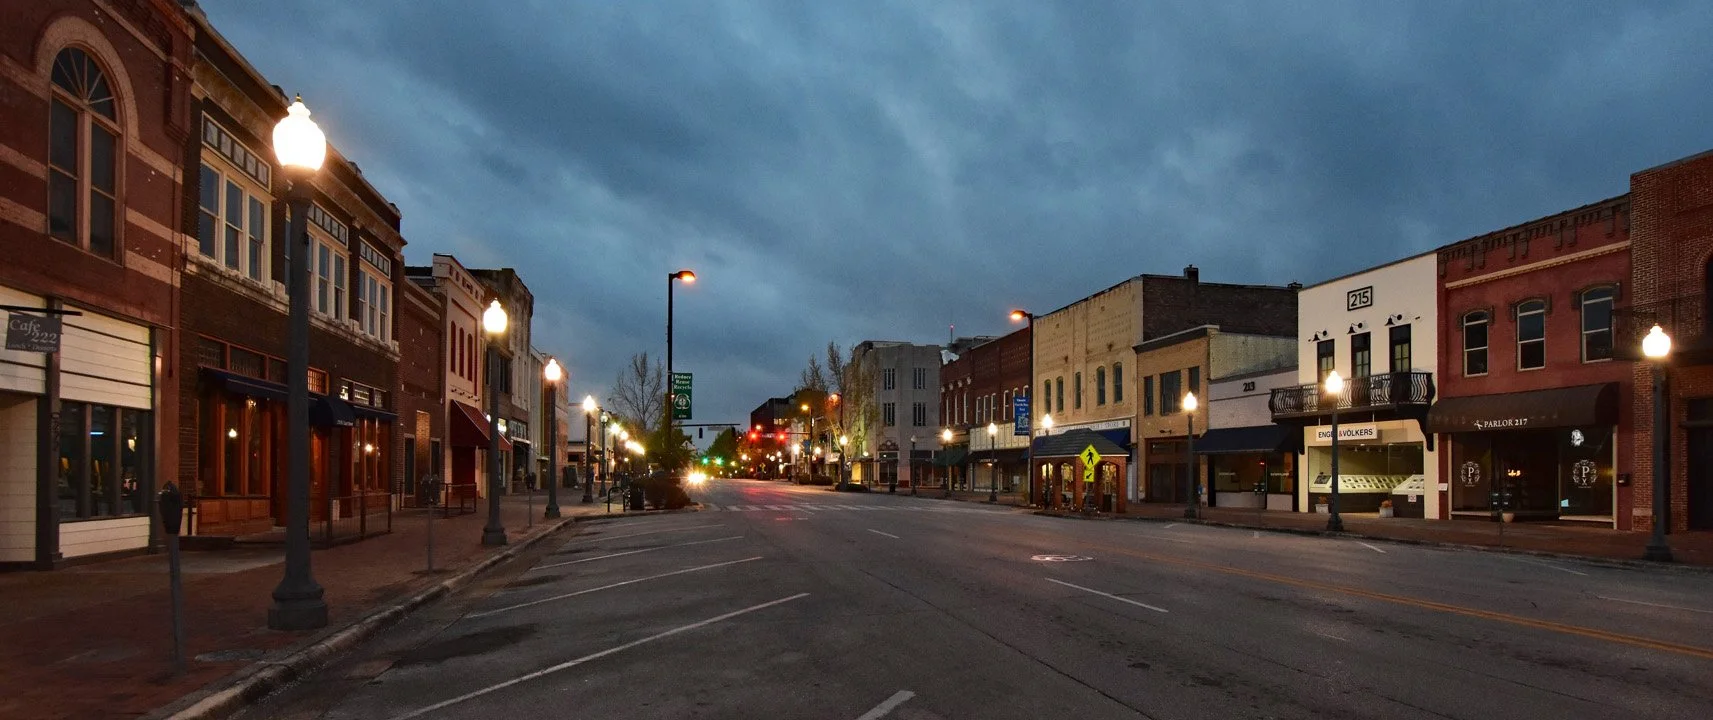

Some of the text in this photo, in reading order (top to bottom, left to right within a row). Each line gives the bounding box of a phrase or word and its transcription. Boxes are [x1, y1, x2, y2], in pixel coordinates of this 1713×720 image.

[1350, 290, 1370, 307] 215
[31, 331, 58, 344] 222
[1242, 381, 1256, 392] 213
[1484, 418, 1528, 428] PARLOR 217
